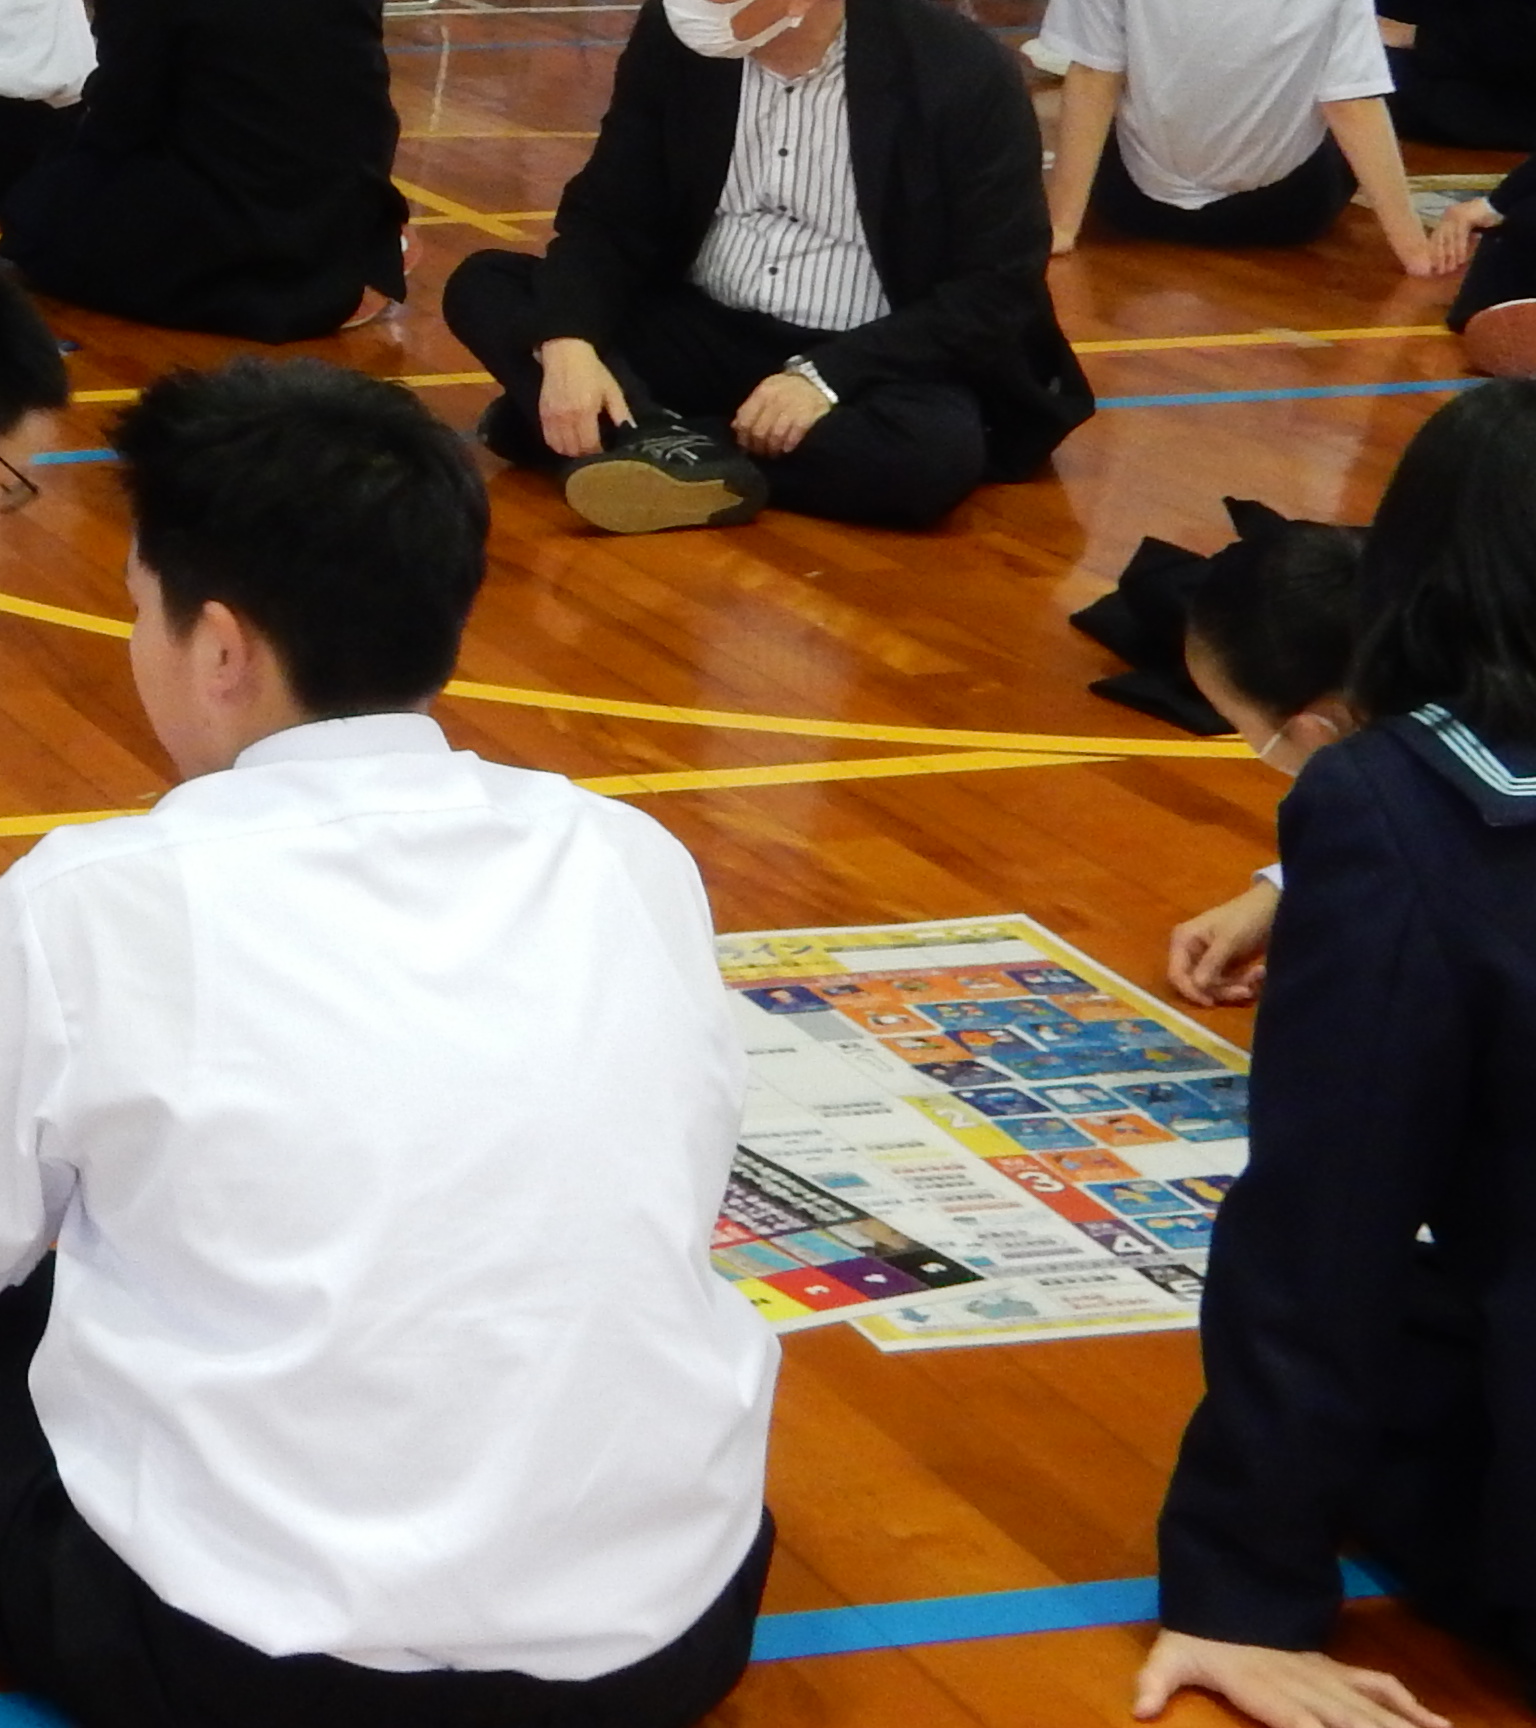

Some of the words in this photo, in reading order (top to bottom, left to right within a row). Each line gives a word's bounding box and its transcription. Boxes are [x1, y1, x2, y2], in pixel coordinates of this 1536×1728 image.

[933, 1108, 980, 1130] 2
[1017, 1170, 1066, 1193] 3
[1111, 1233, 1155, 1258] 4
